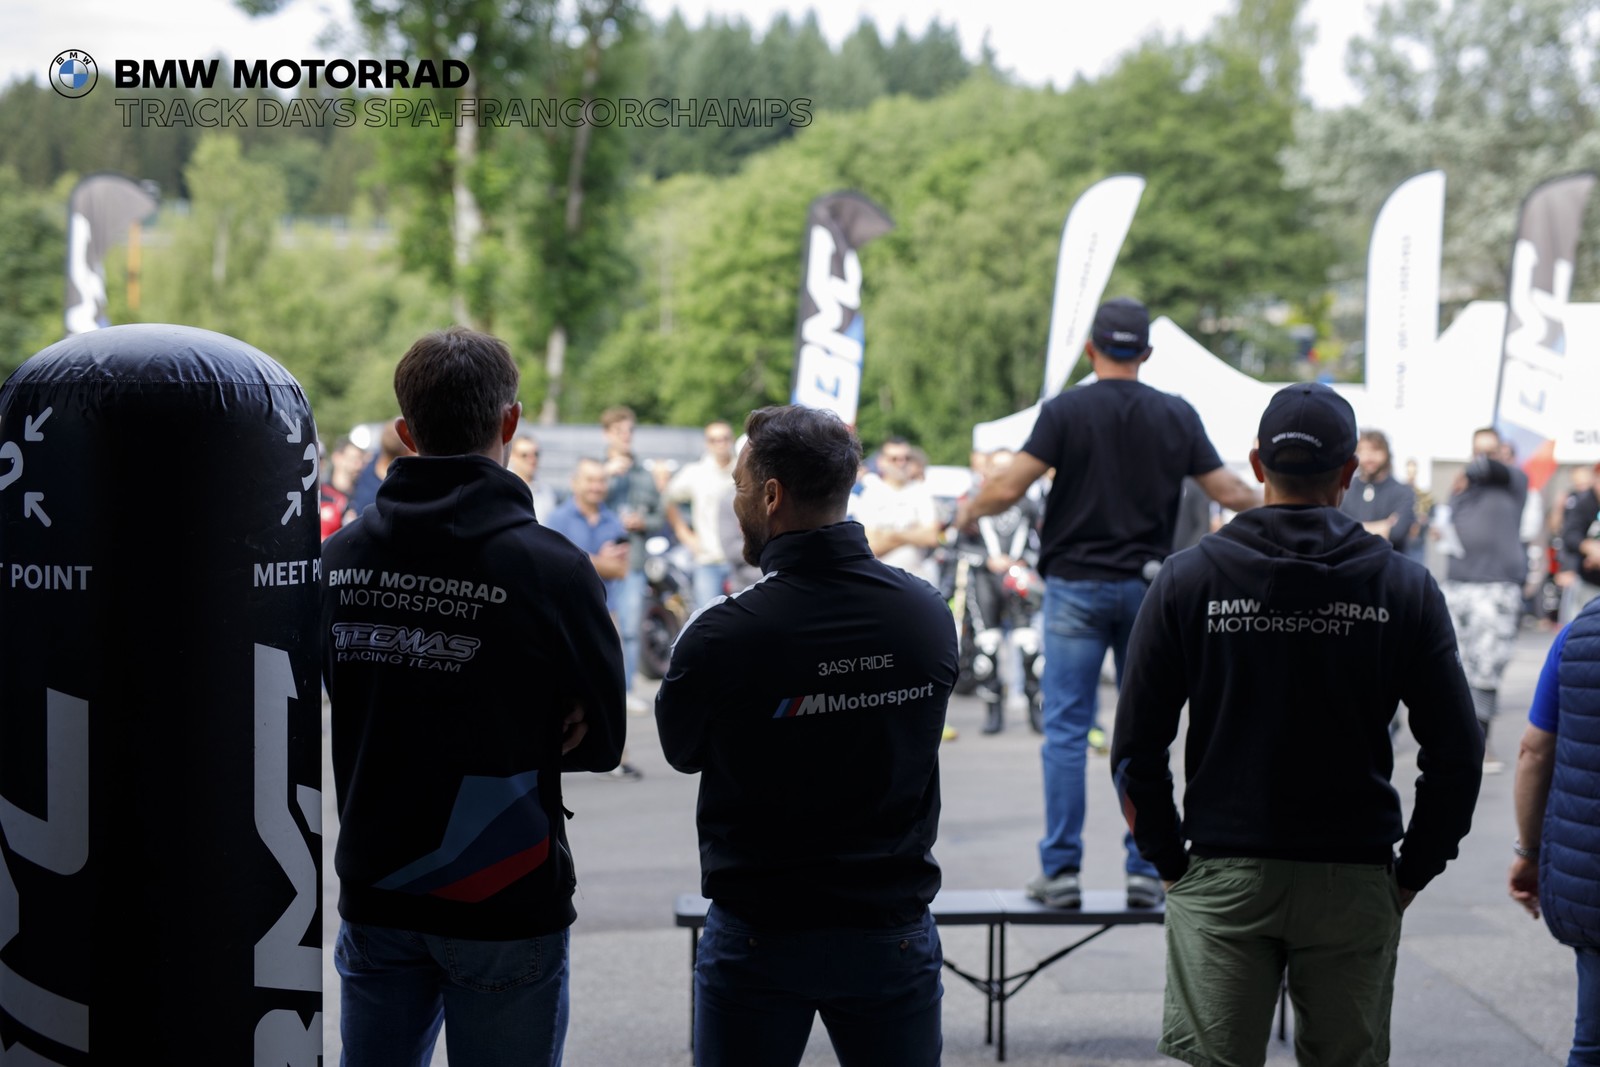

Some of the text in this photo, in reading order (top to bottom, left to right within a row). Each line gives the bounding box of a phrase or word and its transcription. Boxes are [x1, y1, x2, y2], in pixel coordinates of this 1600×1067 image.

[11, 563, 93, 590] POINT
[253, 560, 309, 587] MEET
[328, 568, 373, 587] BMW
[379, 571, 507, 604] MOTORRAD
[340, 589, 483, 620] MOTORSPORT
[1208, 599, 1261, 616] BMW
[1207, 616, 1355, 636] MOTORSPORT
[337, 651, 462, 673] RACING TEAM
[818, 654, 894, 677] 3ASY RIDE
[828, 682, 934, 712] Motorsport
